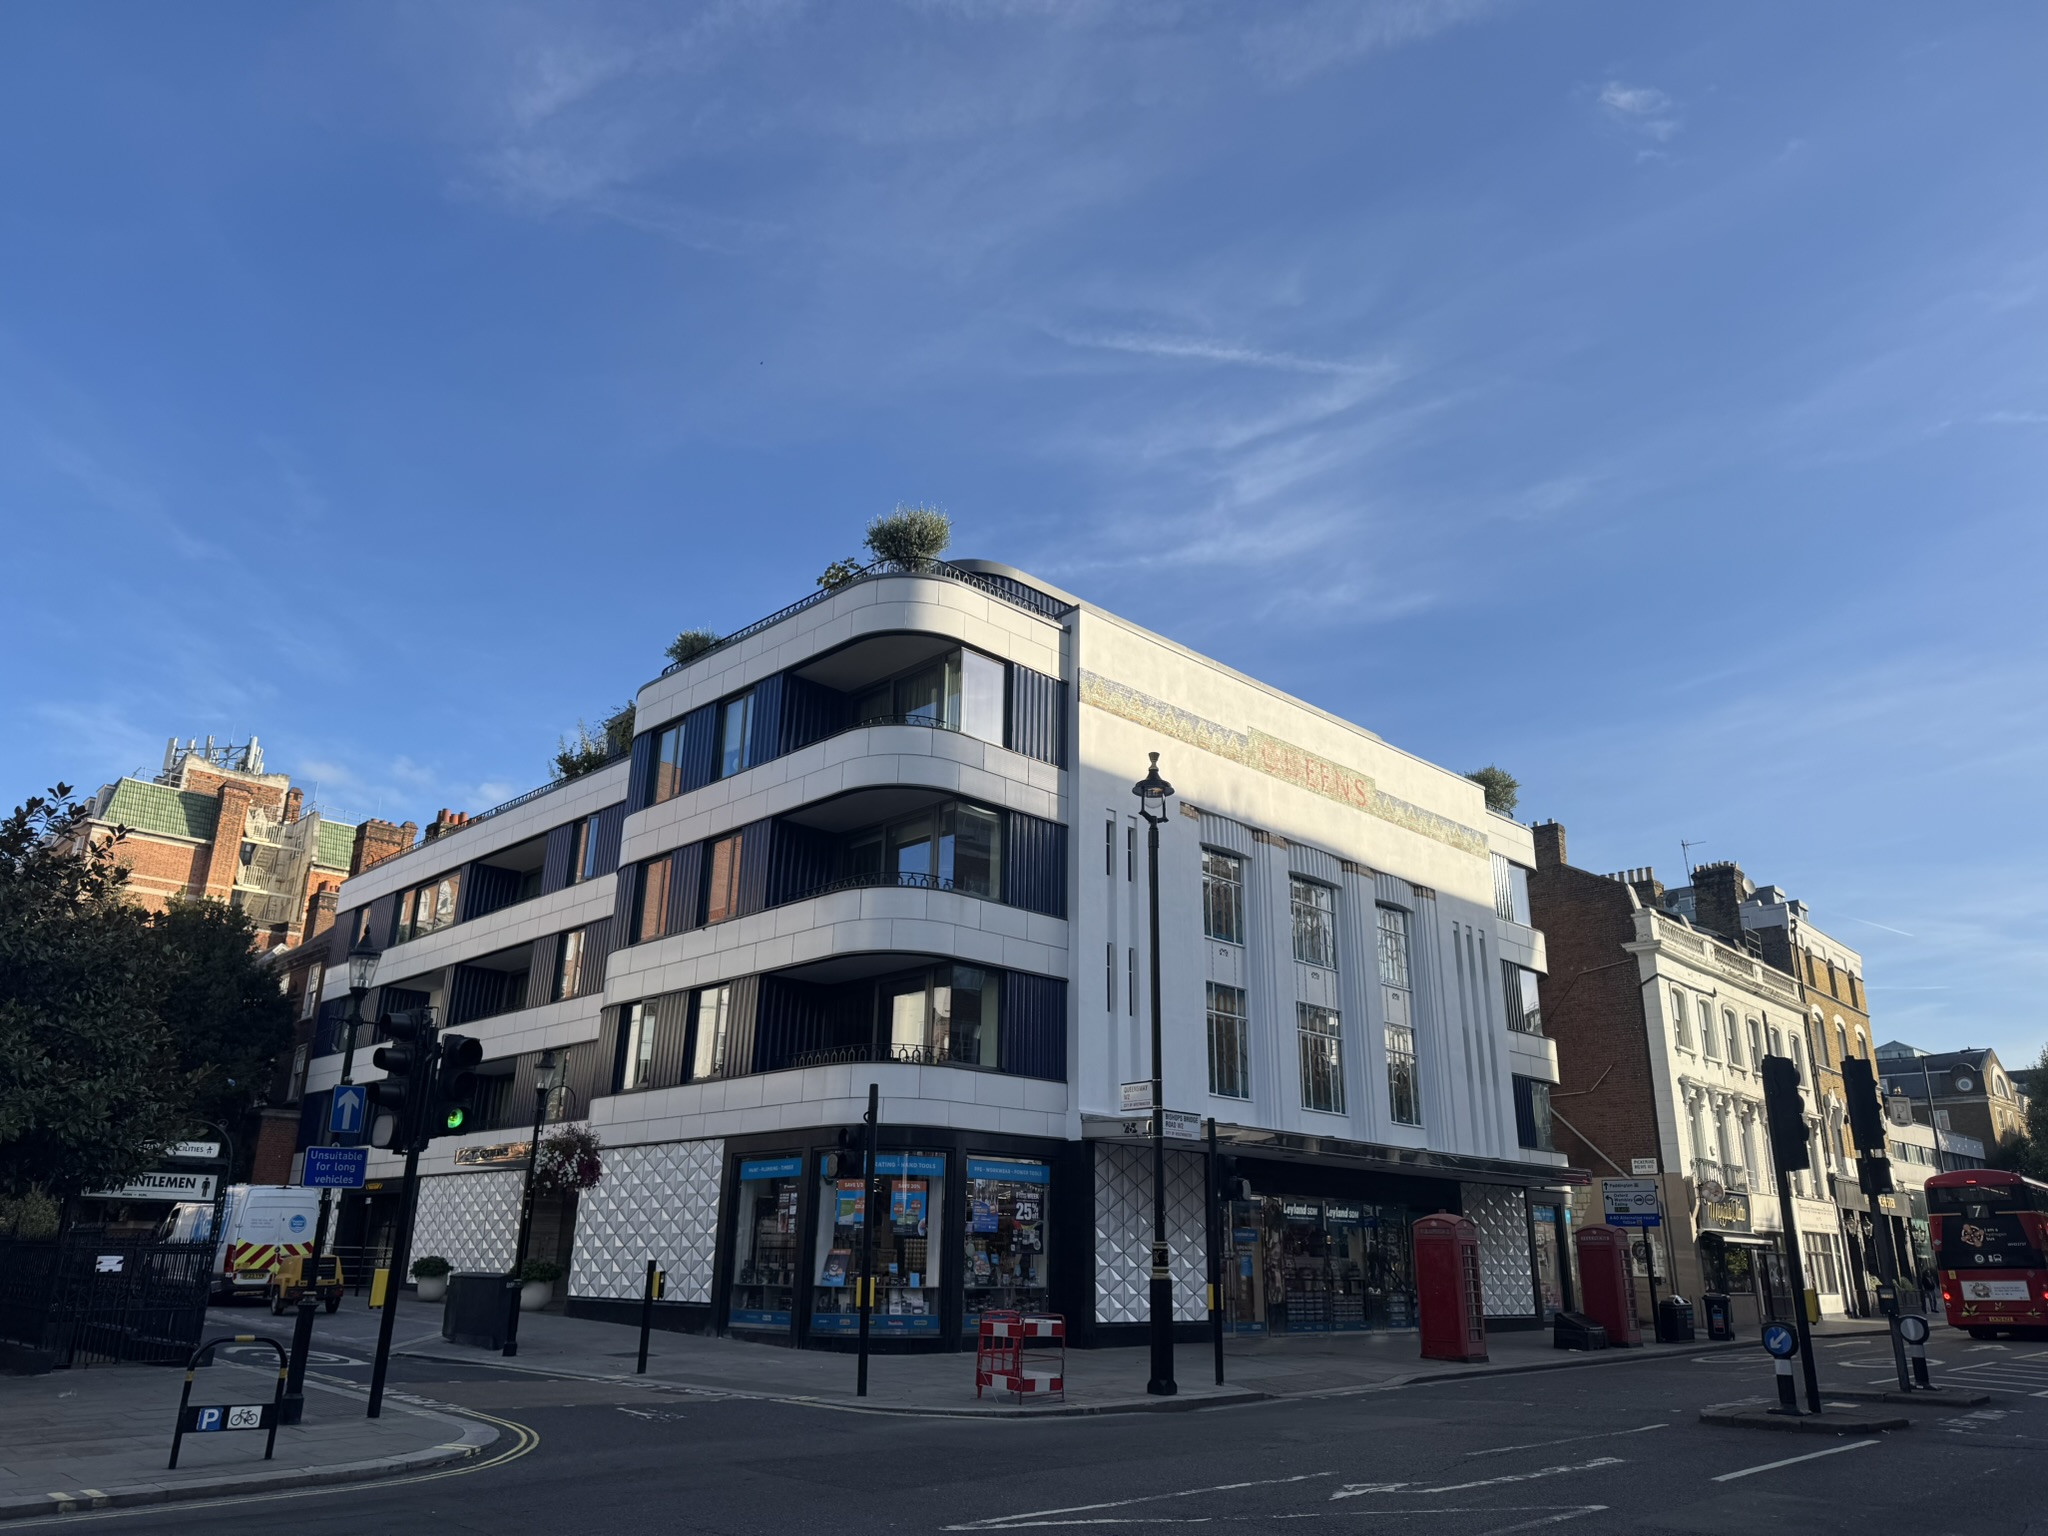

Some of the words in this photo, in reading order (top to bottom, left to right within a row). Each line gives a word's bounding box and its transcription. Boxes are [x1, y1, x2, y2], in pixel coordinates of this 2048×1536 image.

[1262, 740, 1368, 807] QUEENS
[1124, 1085, 1148, 1094] QUEENSWAY
[310, 1150, 363, 1160] Unsuitable
[316, 1162, 331, 1171] for
[334, 1162, 355, 1173] long
[127, 1175, 196, 1188] ENTLEMEN
[314, 1174, 353, 1184] vehicles
[1283, 1202, 1307, 1216] Leyland
[1326, 1206, 1349, 1219] Leyland
[1972, 1205, 1981, 1218] 7
[202, 1409, 219, 1430] P
